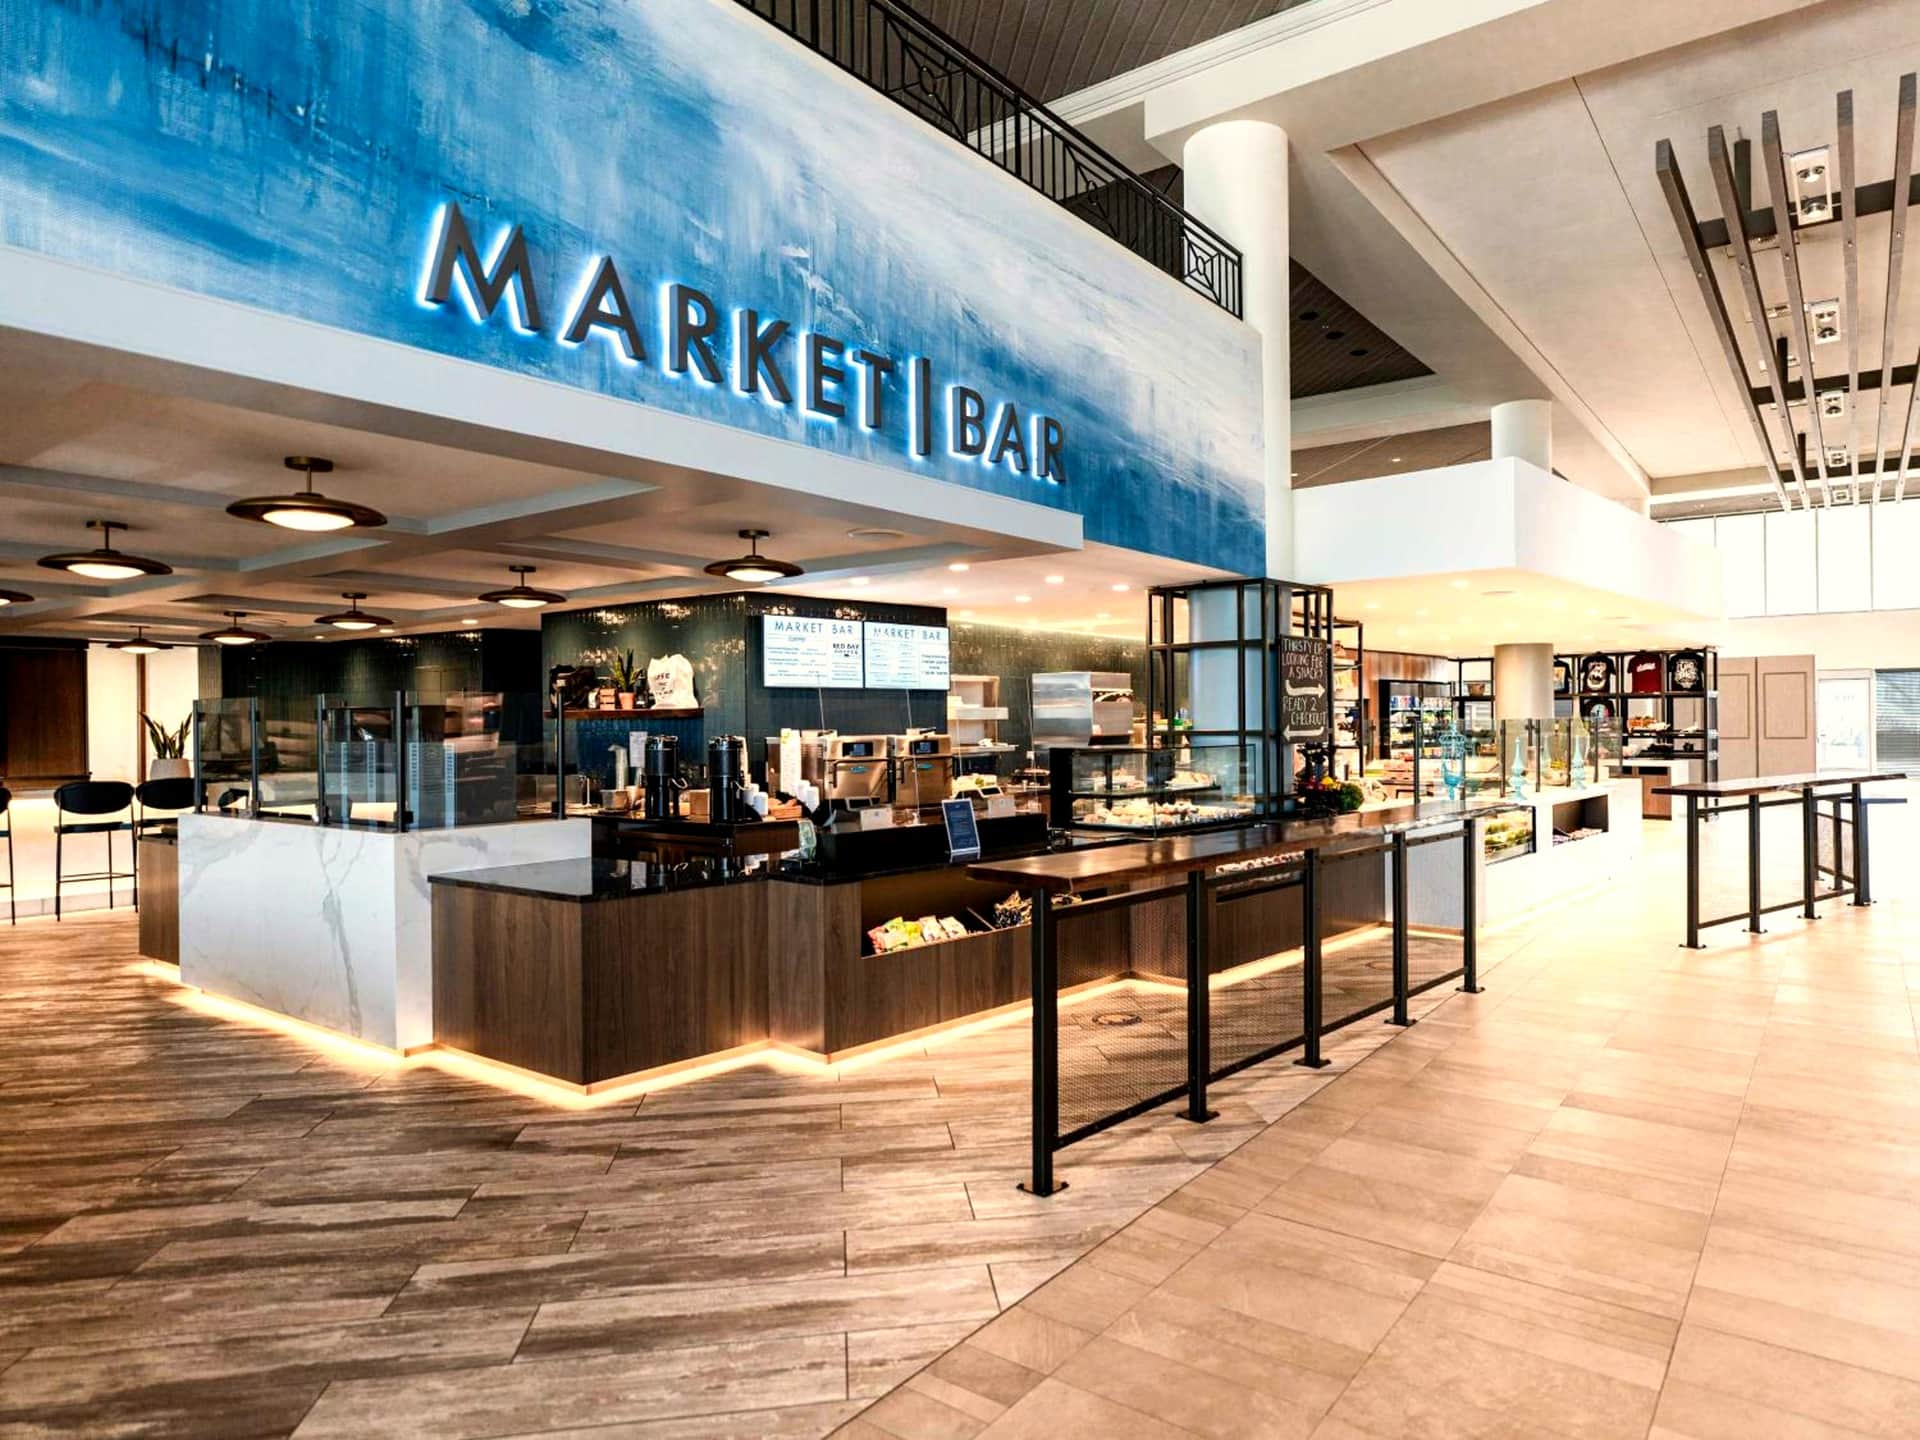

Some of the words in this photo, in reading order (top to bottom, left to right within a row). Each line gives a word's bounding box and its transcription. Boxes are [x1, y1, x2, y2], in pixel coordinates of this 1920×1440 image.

[424, 200, 893, 429] MARKET
[952, 385, 1066, 483] BAR
[775, 621, 823, 634] MARKET
[831, 624, 853, 635] BAR
[873, 626, 915, 639] MARKET
[922, 630, 942, 641] BAR
[1289, 666, 1295, 679] A
[1310, 696, 1317, 712] 2
